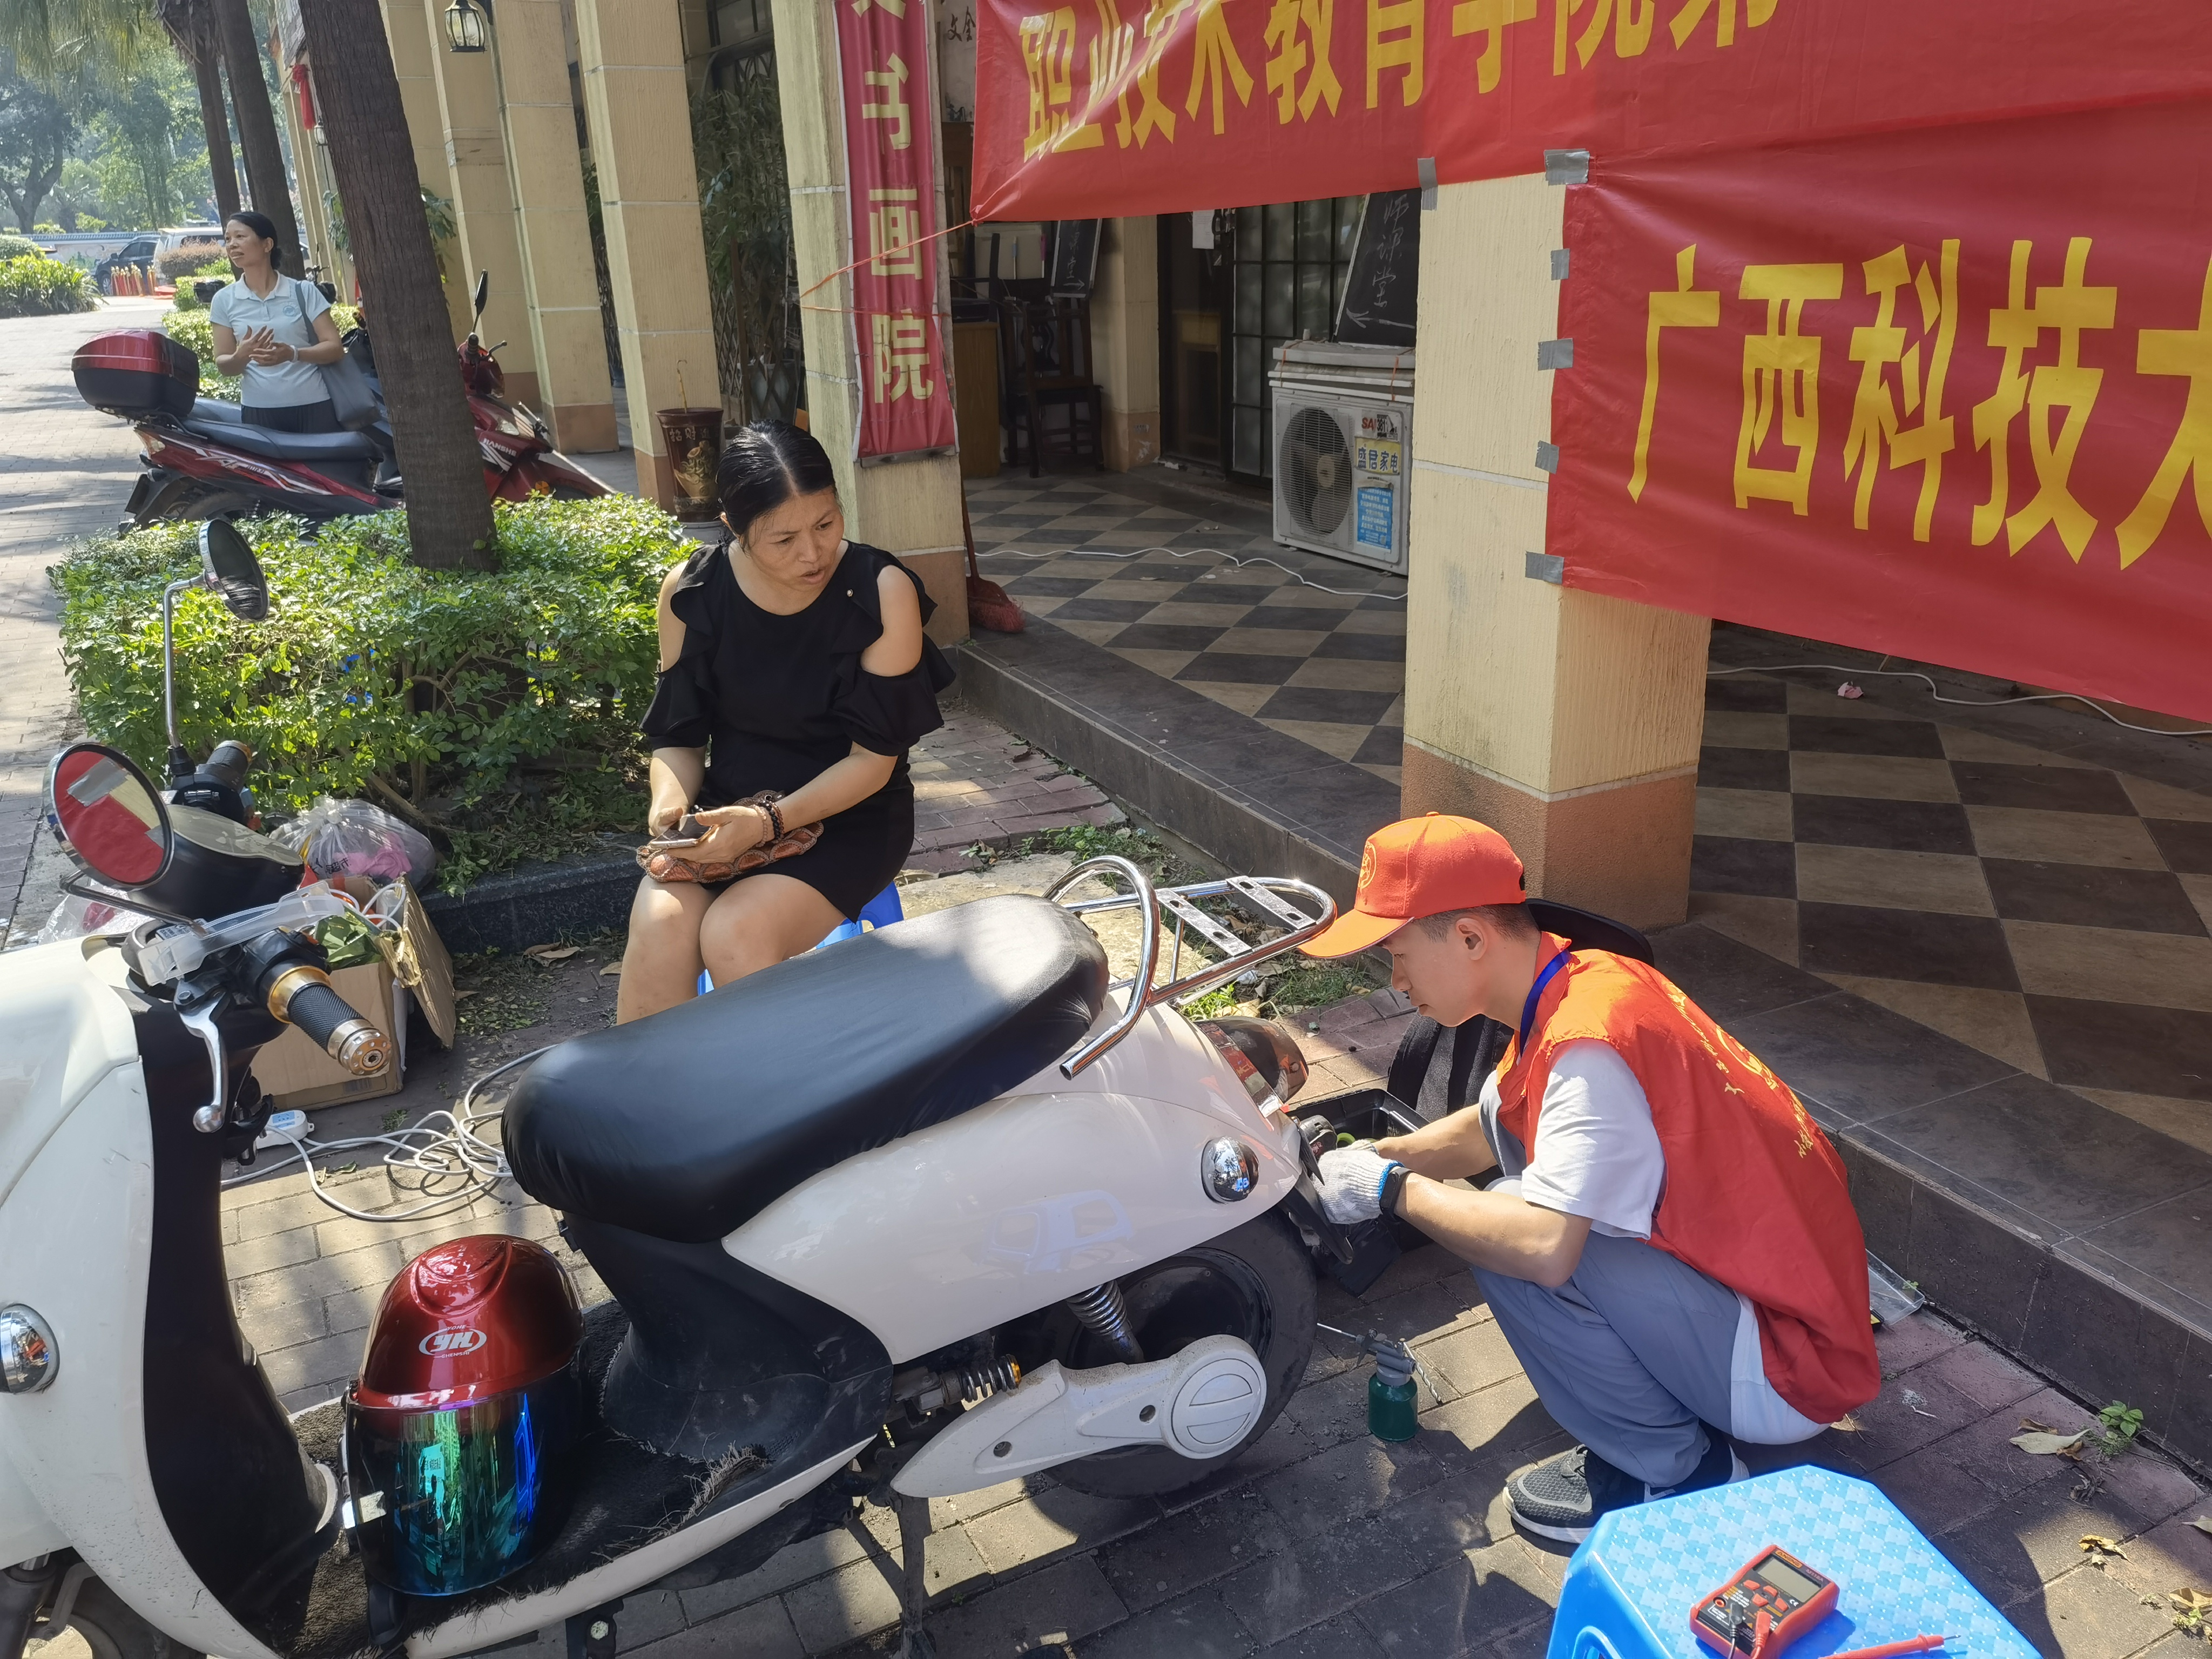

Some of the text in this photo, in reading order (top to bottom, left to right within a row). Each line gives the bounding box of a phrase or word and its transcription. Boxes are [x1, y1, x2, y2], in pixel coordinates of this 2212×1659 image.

[1019, 0, 1776, 163] 职业技术教育
[851, 0, 934, 403] 书画院
[430, 1331, 474, 1352] YH
